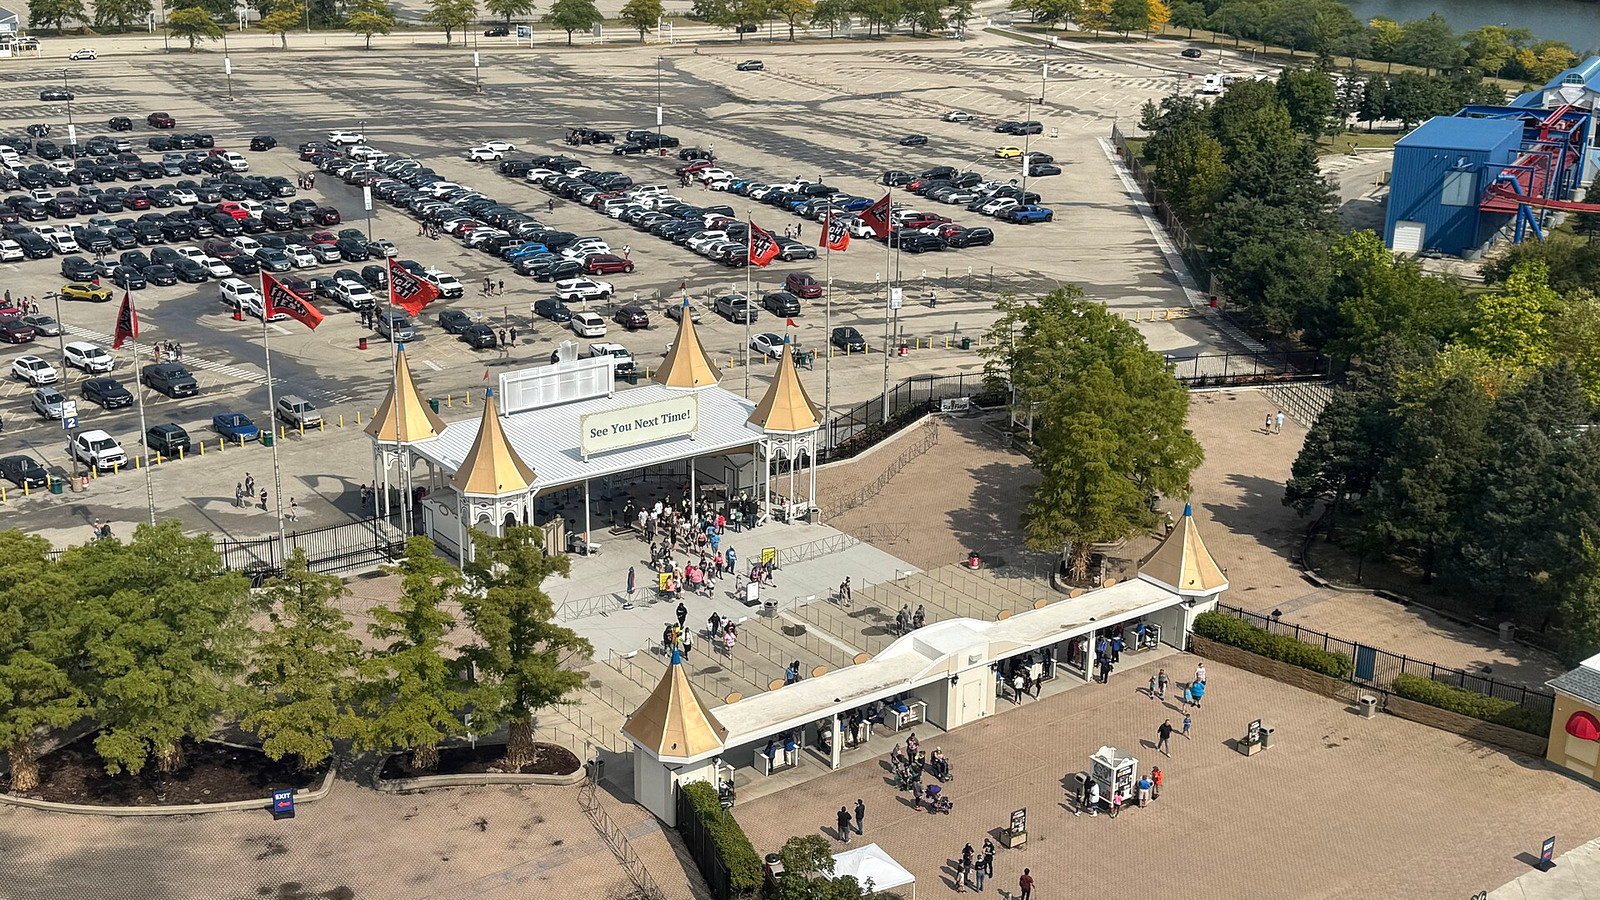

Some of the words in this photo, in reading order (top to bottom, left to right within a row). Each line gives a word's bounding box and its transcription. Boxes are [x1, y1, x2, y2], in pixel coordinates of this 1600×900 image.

[68, 418, 76, 428] 2
[590, 428, 609, 438] See
[611, 423, 632, 434] You
[634, 417, 659, 430] Next
[661, 409, 690, 424] Time!
[275, 792, 291, 800] EXIT
